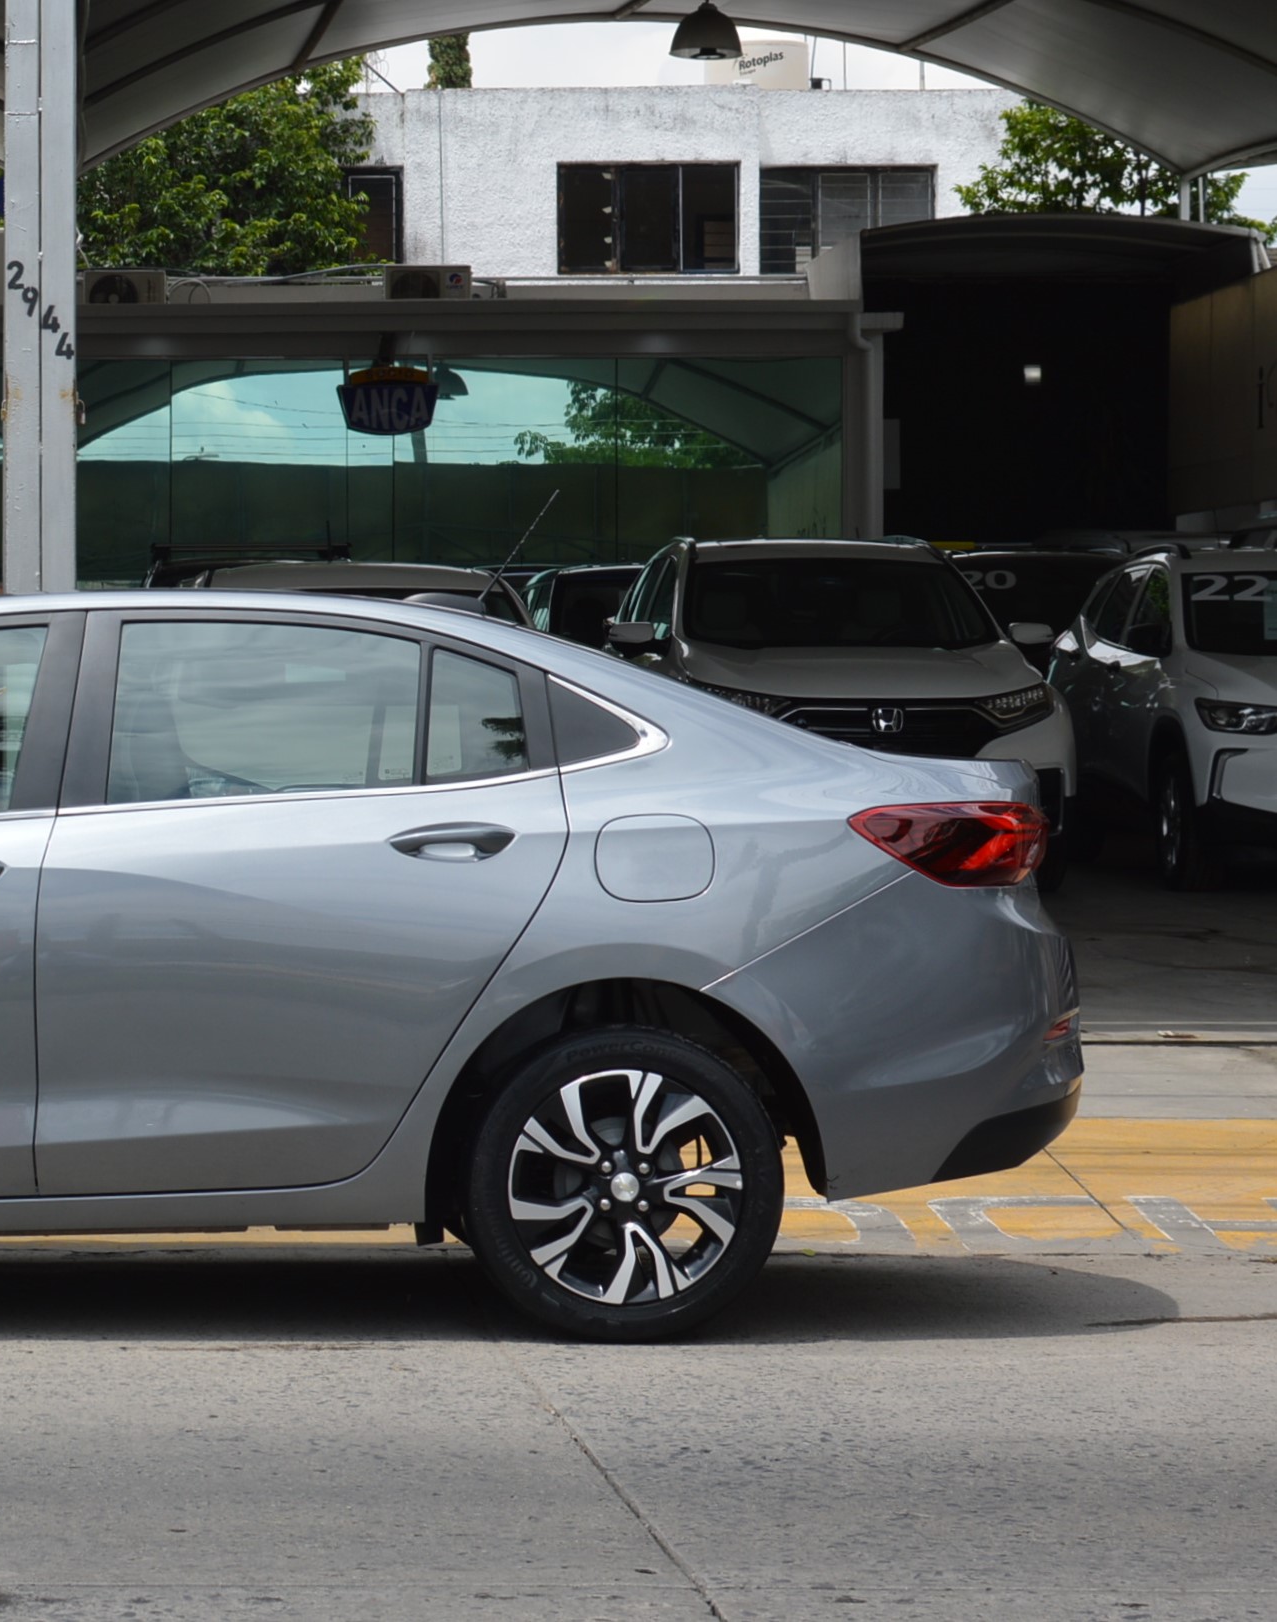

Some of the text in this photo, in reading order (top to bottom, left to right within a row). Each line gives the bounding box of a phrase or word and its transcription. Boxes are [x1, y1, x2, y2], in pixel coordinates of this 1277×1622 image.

[739, 51, 784, 71] Rotoplas
[6, 260, 75, 361] 2944
[350, 386, 430, 431] ANCA
[1190, 574, 1273, 602] 22
